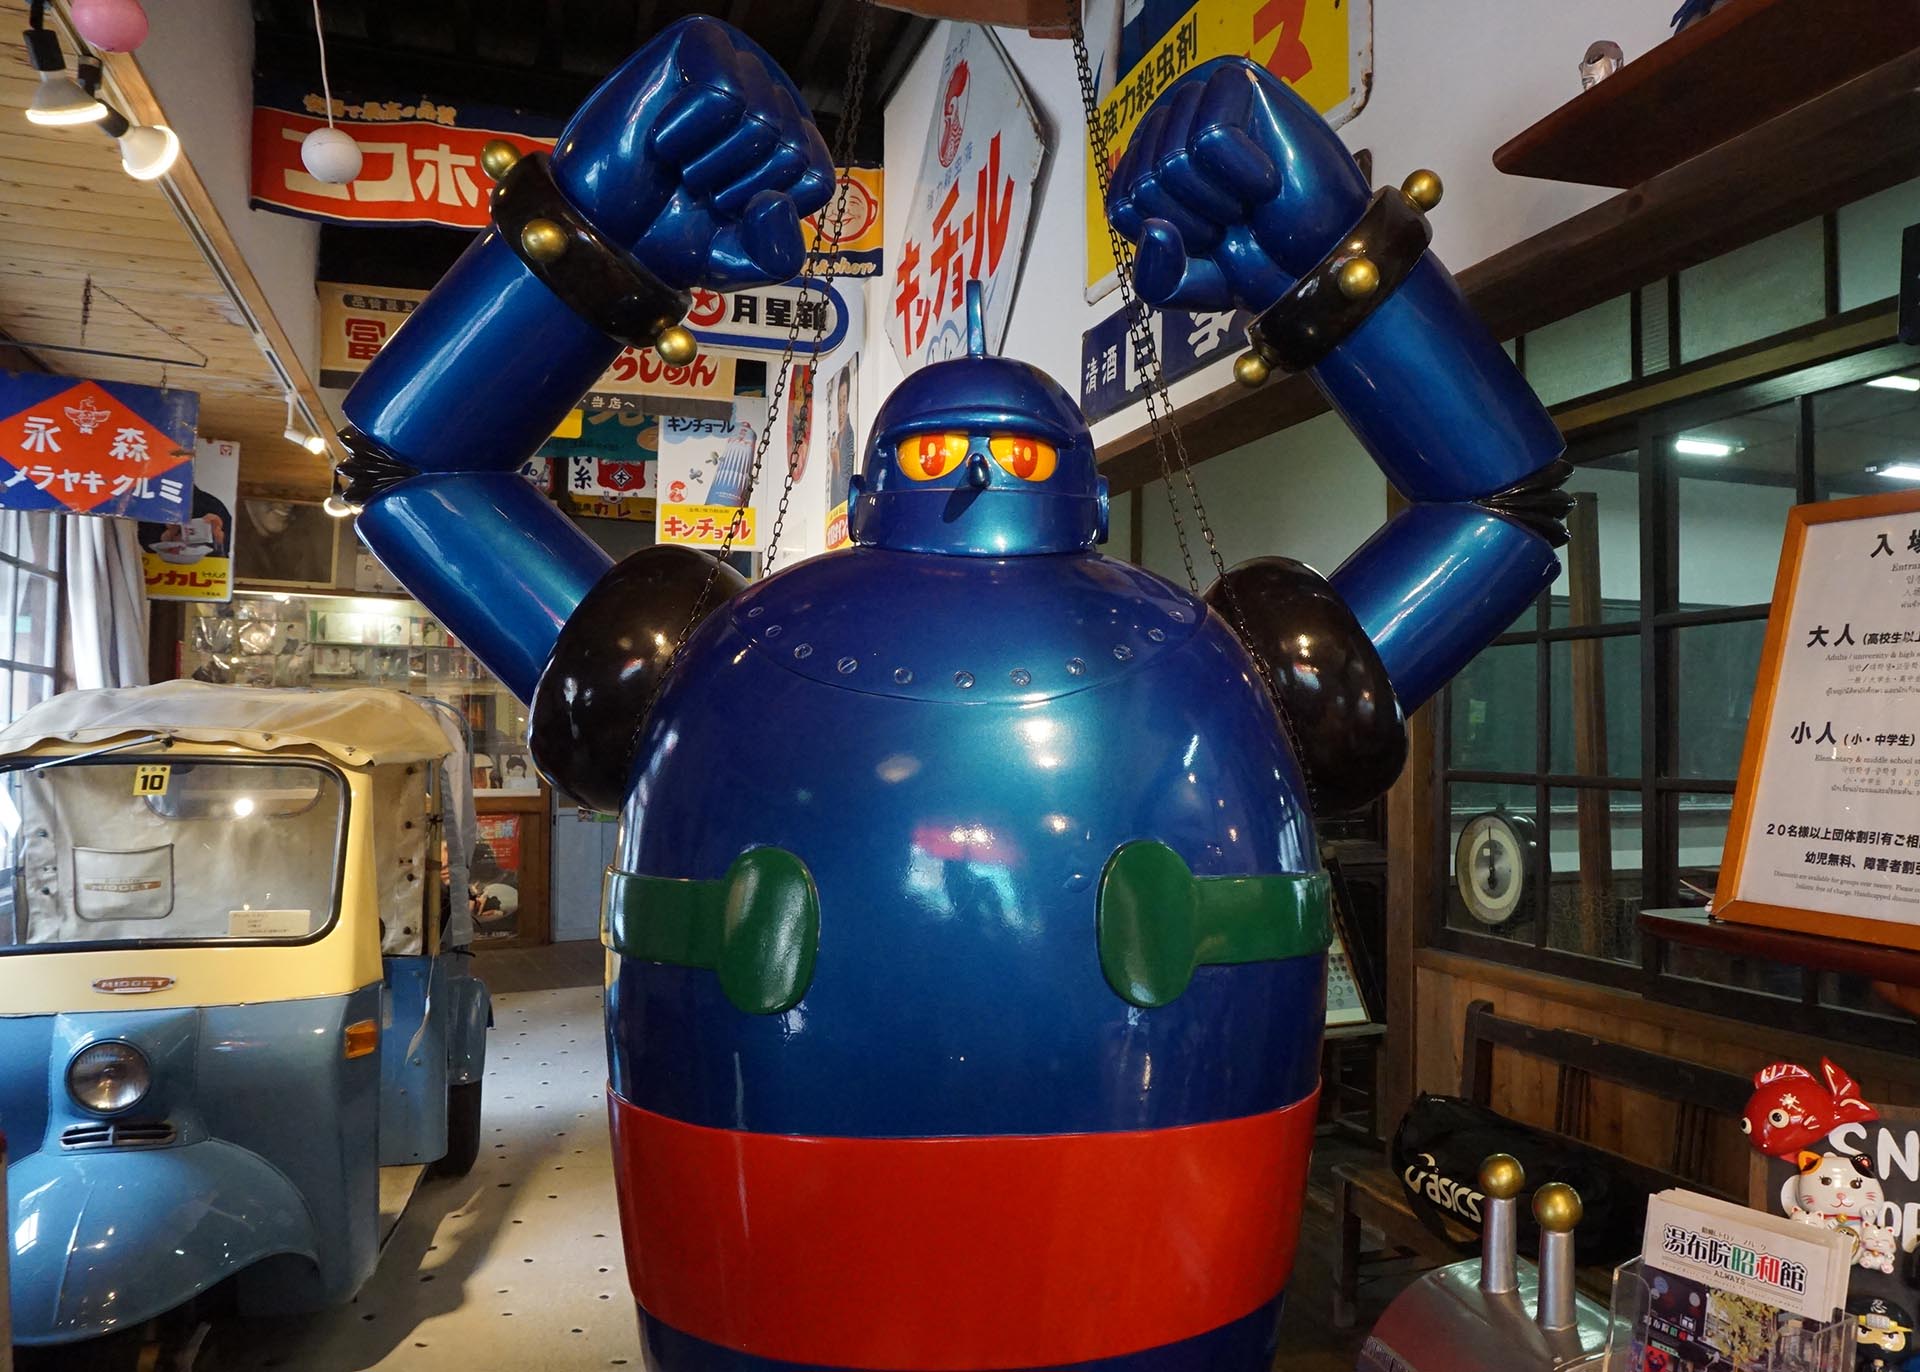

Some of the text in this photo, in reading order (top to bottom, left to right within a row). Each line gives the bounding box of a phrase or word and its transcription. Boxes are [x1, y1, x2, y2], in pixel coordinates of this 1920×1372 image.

[282, 128, 493, 208] ニコホ
[1085, 344, 1118, 394] 清酒
[591, 396, 635, 409] 当店へ
[667, 416, 735, 433] キンチョール
[664, 516, 751, 540] キンチョール
[1807, 624, 1855, 648] 大人
[1791, 721, 1837, 745] 小人
[1889, 757, 1913, 765] school
[141, 775, 164, 791] 10
[1766, 823, 1920, 849] 20名様以上団体割引有ご相
[101, 979, 164, 990] MIDGET
[1426, 1174, 1486, 1223] asics
[1664, 1224, 1807, 1295] 湯布院昭和館
[1713, 1270, 1746, 1286] ALWAYS
